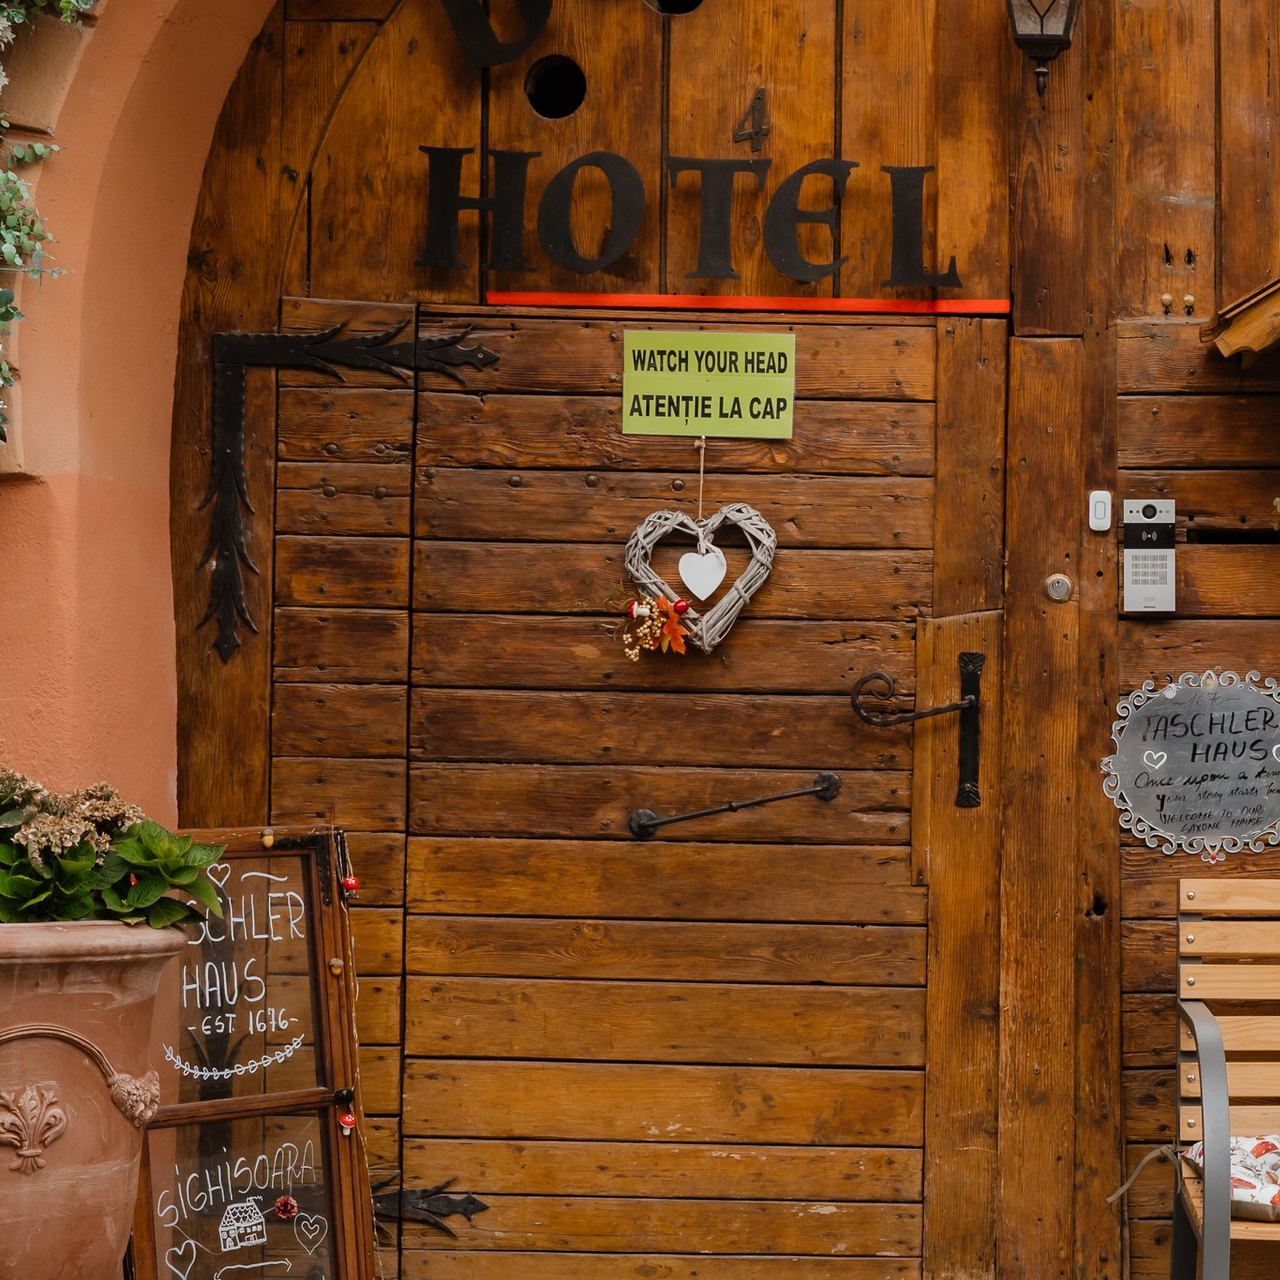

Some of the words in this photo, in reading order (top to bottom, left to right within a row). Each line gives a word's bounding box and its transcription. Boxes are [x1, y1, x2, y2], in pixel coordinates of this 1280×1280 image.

[733, 87, 769, 152] 4
[413, 144, 965, 288] HOTEL
[631, 349, 689, 372] WATCH
[694, 350, 739, 373] YOUR
[744, 351, 788, 374] HEAD
[718, 396, 743, 419] LA
[748, 396, 788, 420] CAP
[1140, 706, 1279, 742] TASCHLER
[1190, 739, 1268, 763] HAUS
[1159, 809, 1214, 824] WELCOME
[1221, 808, 1233, 819] TO
[1241, 804, 1264, 816] OUR
[182, 957, 266, 1008] HAUS
